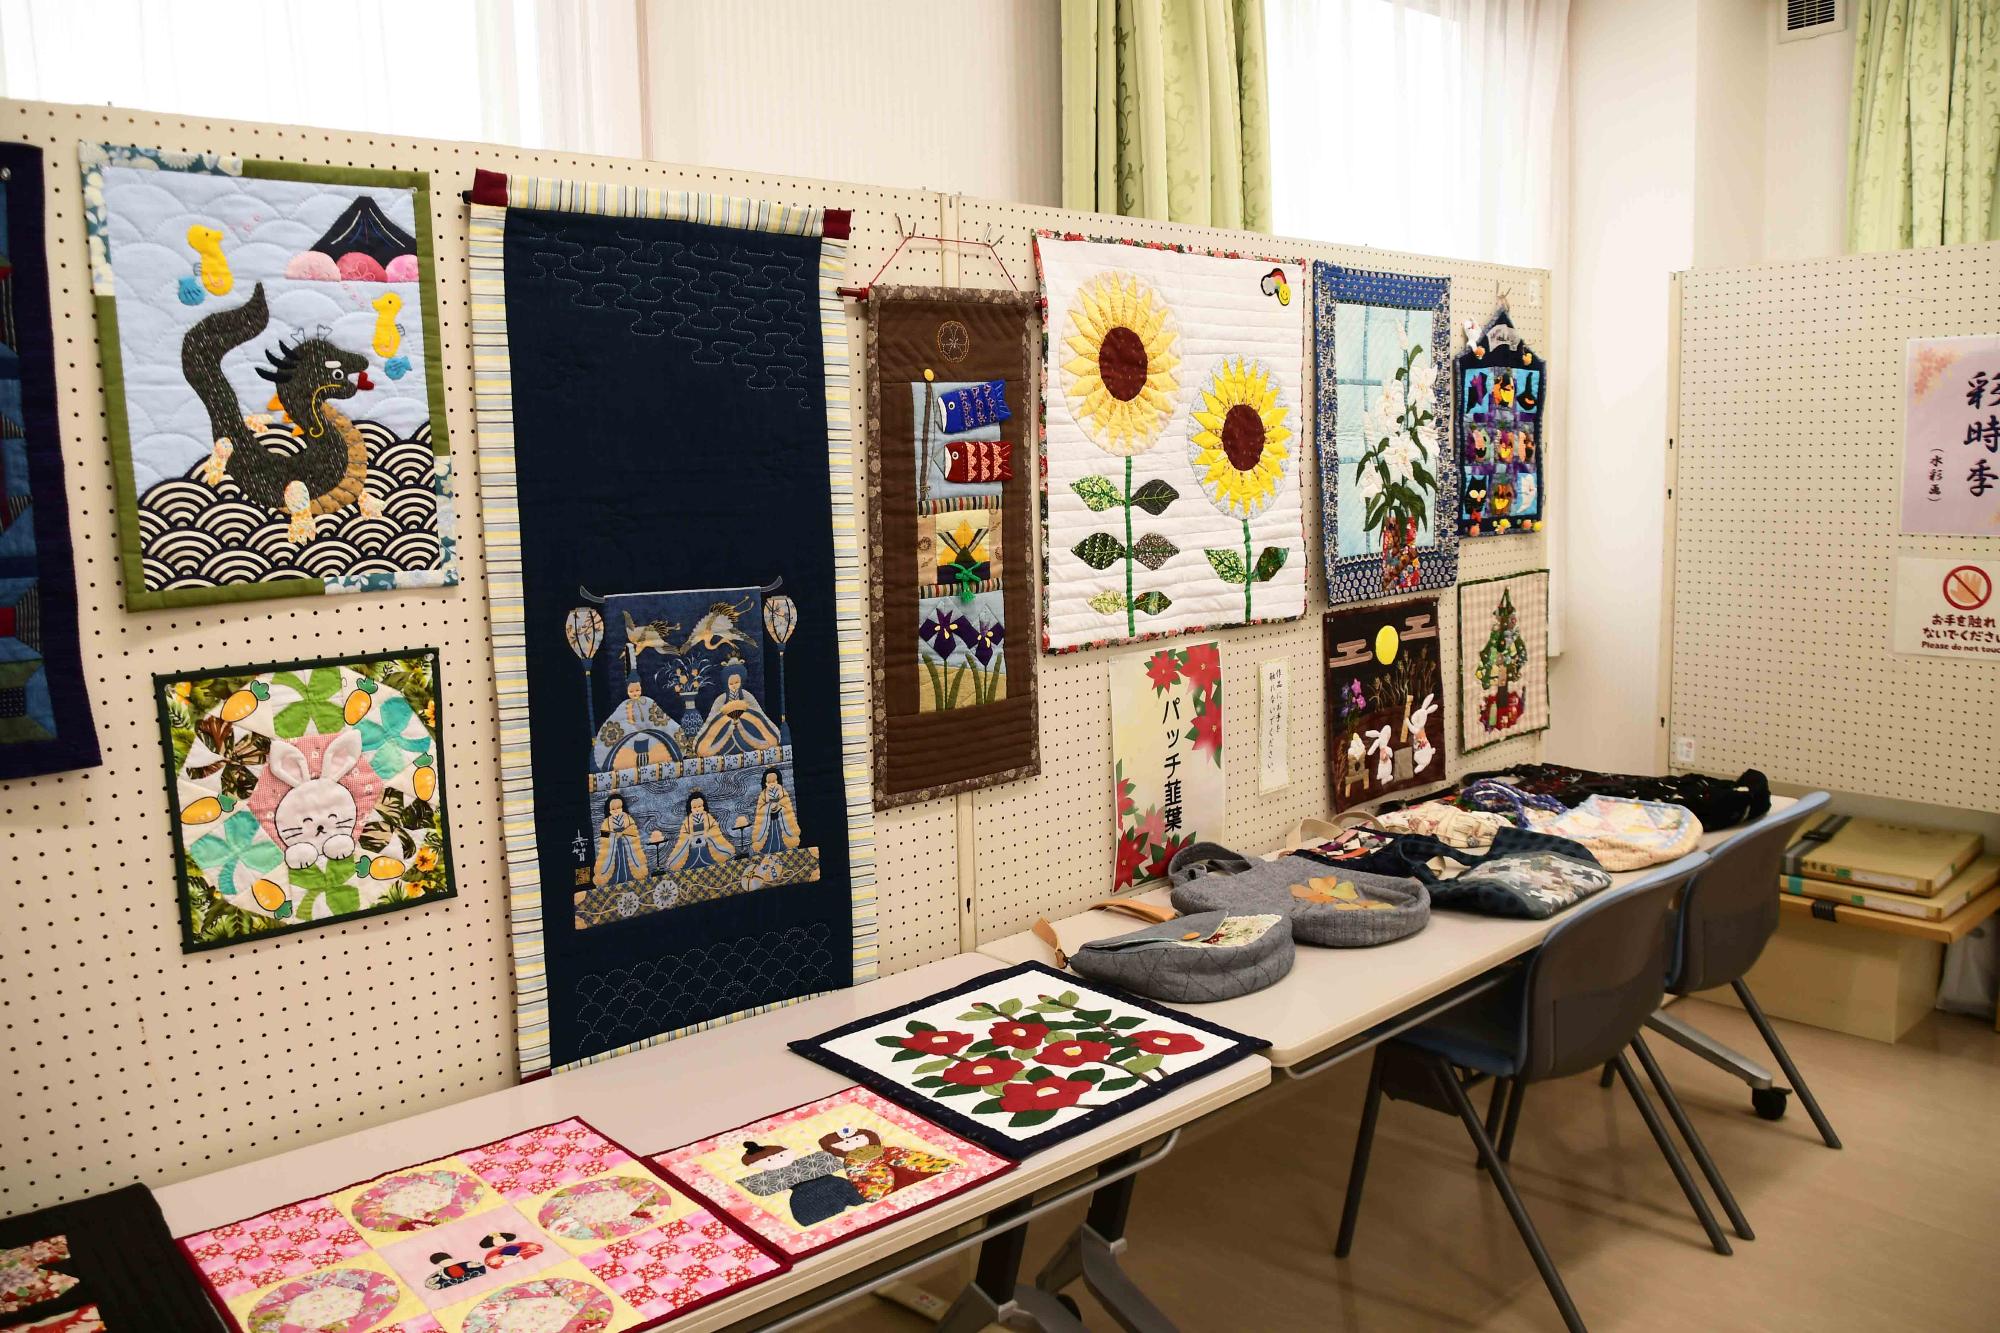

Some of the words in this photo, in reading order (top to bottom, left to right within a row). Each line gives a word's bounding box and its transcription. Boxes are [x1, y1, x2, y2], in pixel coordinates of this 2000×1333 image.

[1931, 613, 1996, 628] お手を触れ
[1921, 641, 1949, 650] Please
[1951, 643, 1962, 651] do
[1162, 696, 1183, 833] パッチ韮葉
